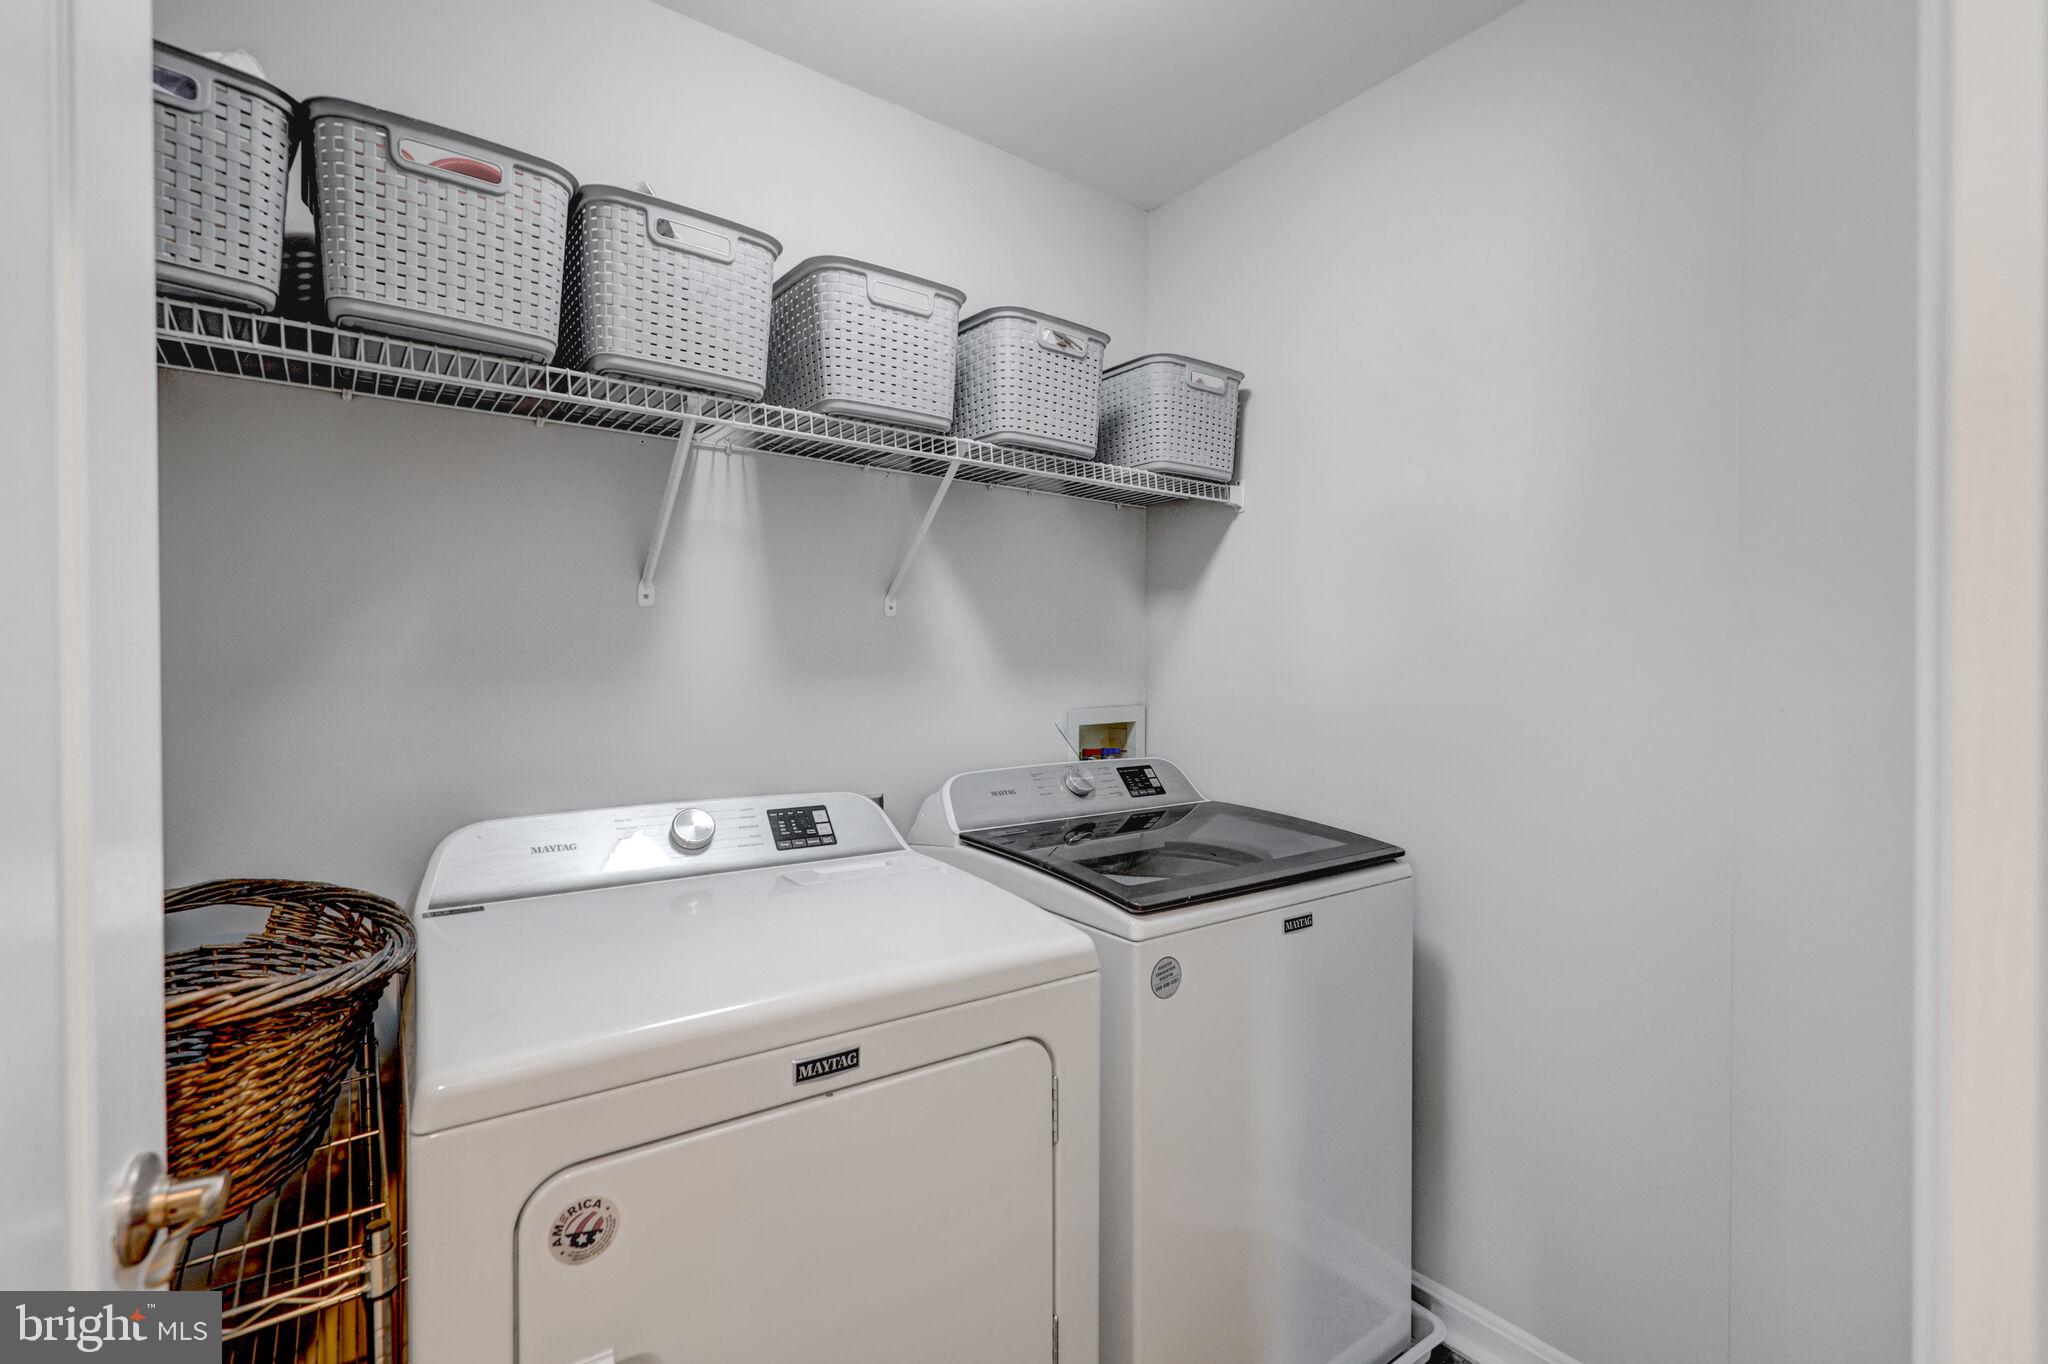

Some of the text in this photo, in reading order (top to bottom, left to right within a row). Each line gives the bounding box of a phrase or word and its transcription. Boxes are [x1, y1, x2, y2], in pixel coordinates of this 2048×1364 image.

[990, 788, 1017, 797] MAYTAG
[530, 843, 577, 855] MAYTAG
[1285, 916, 1312, 932] MAYTAG
[798, 1052, 857, 1080] MAYTAG
